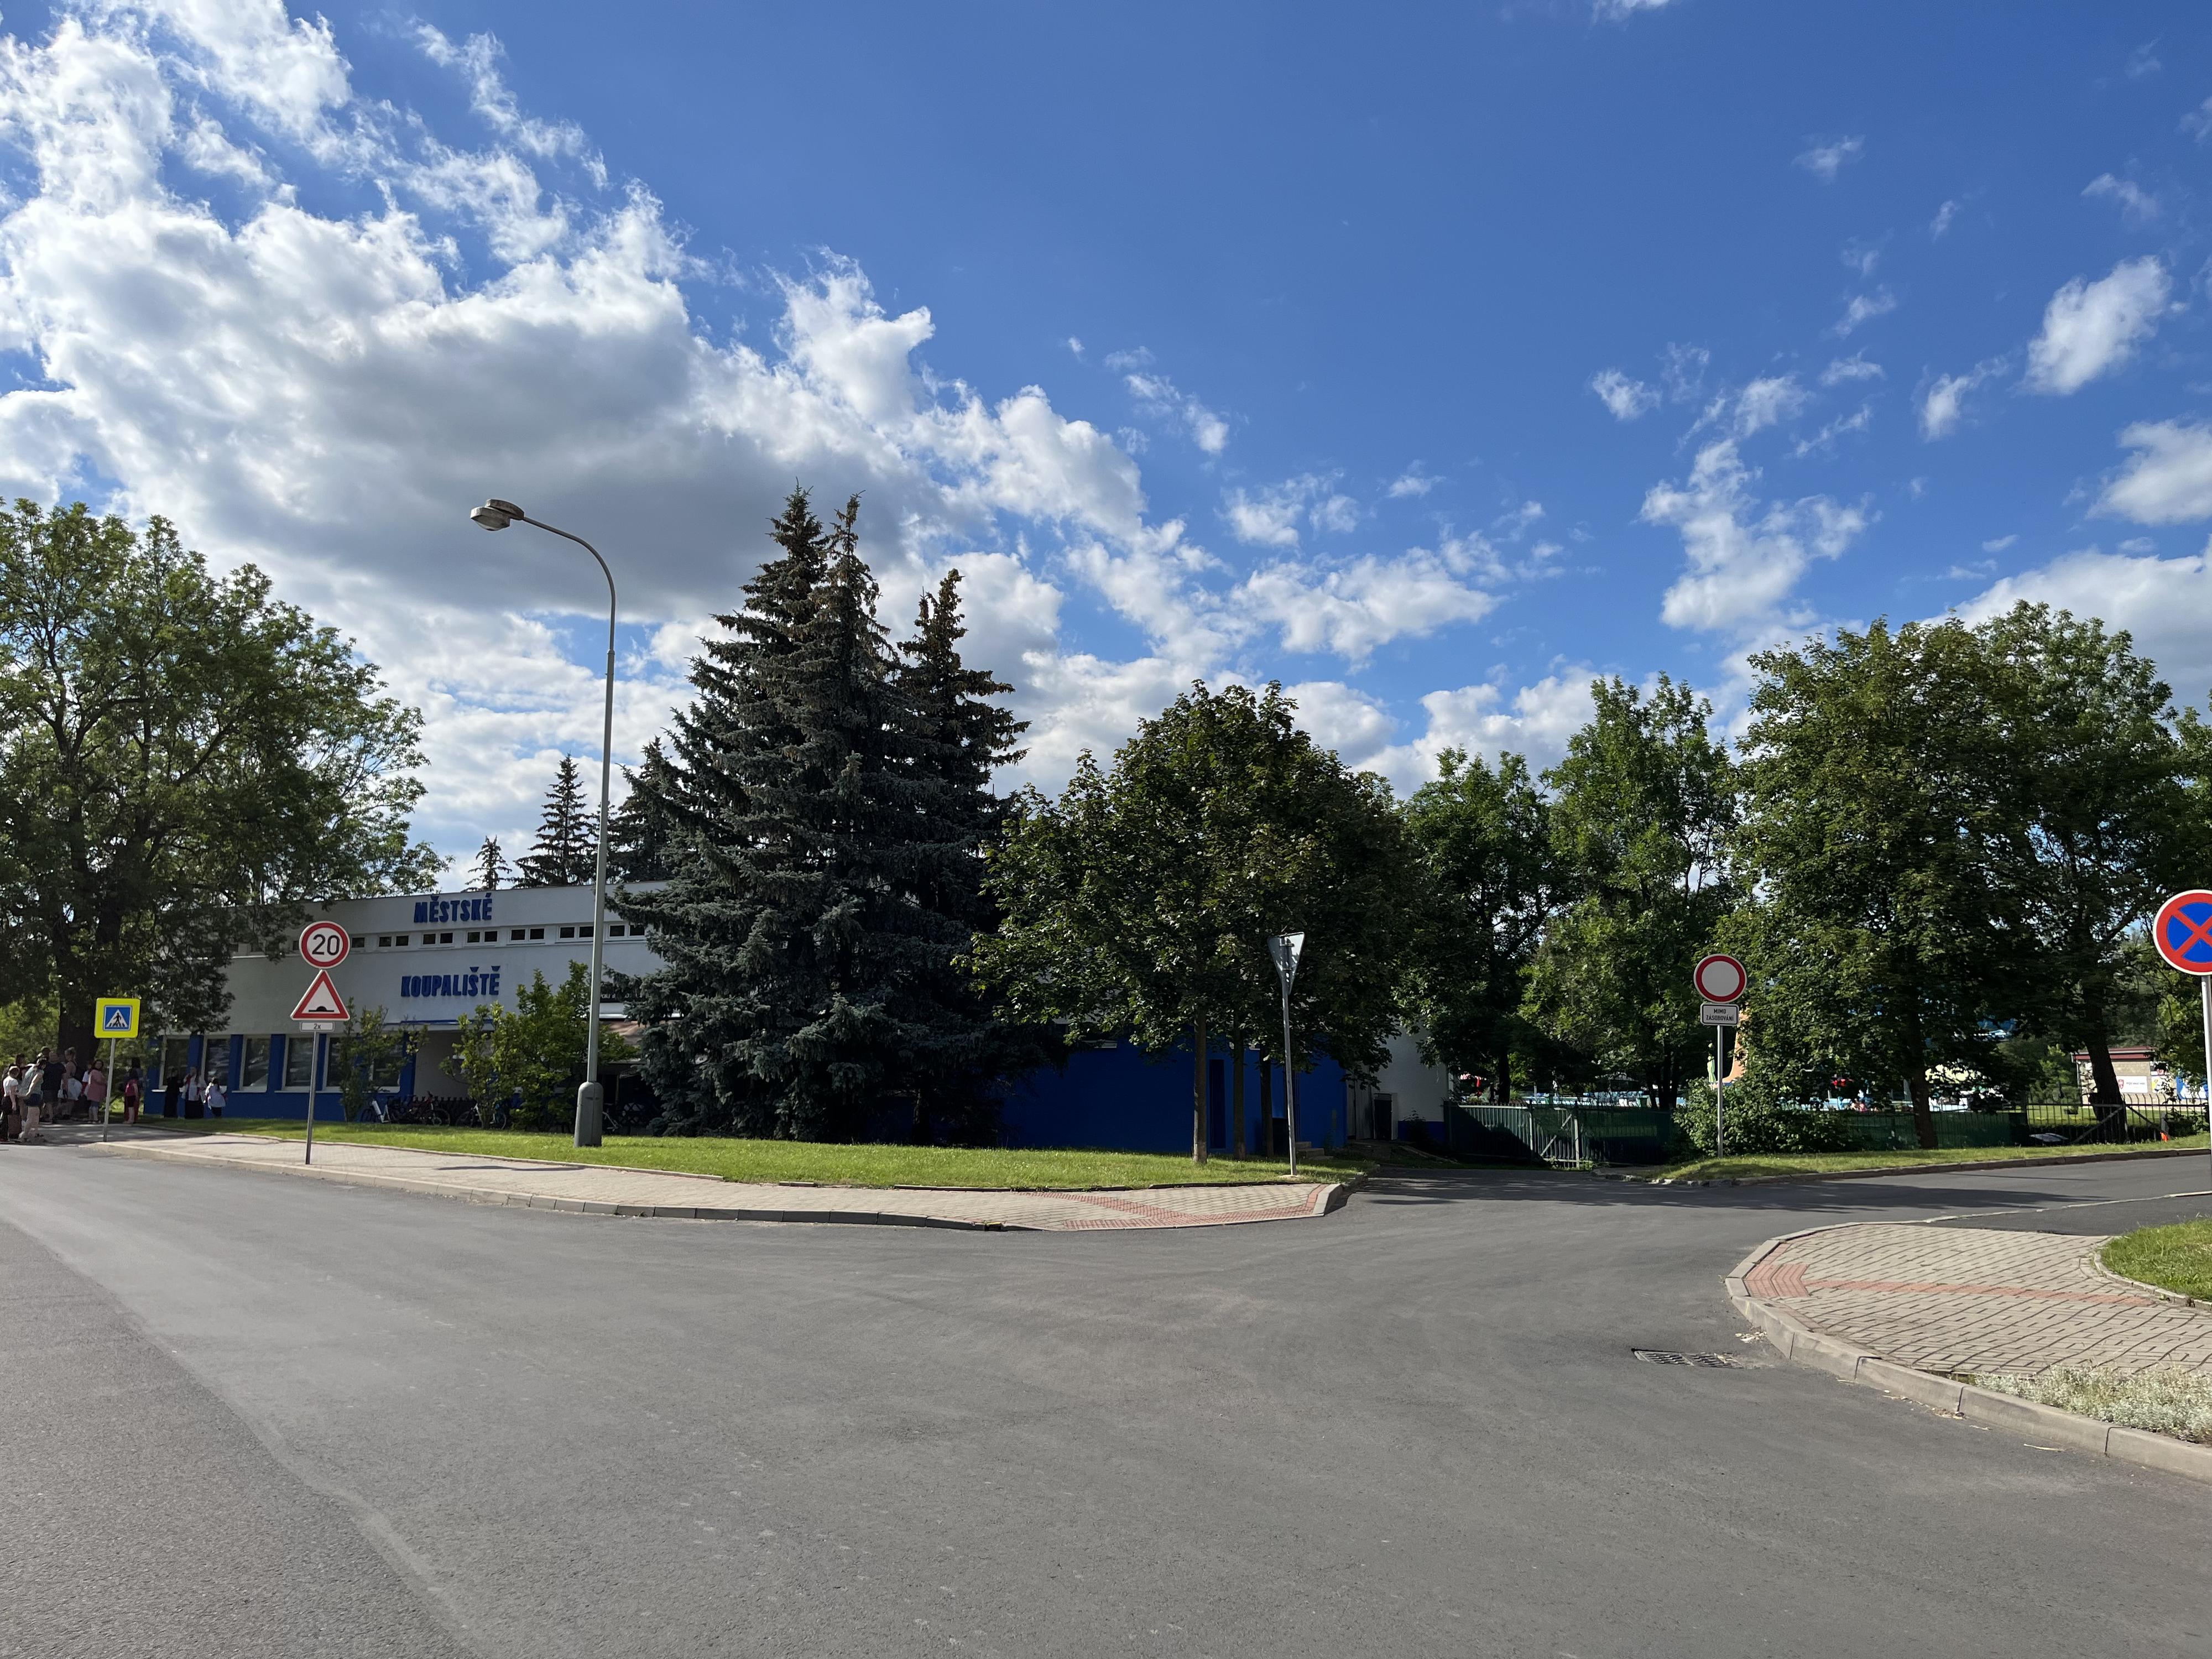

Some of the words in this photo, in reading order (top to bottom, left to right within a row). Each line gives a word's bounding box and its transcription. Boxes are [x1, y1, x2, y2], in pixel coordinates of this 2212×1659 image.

[414, 893, 493, 924] MĚSTSKÉ
[312, 934, 340, 956] 20
[400, 965, 501, 998] KOUPALIŠTĚ
[1706, 1013, 1734, 1021] ZÁSOBOVÁNÍ
